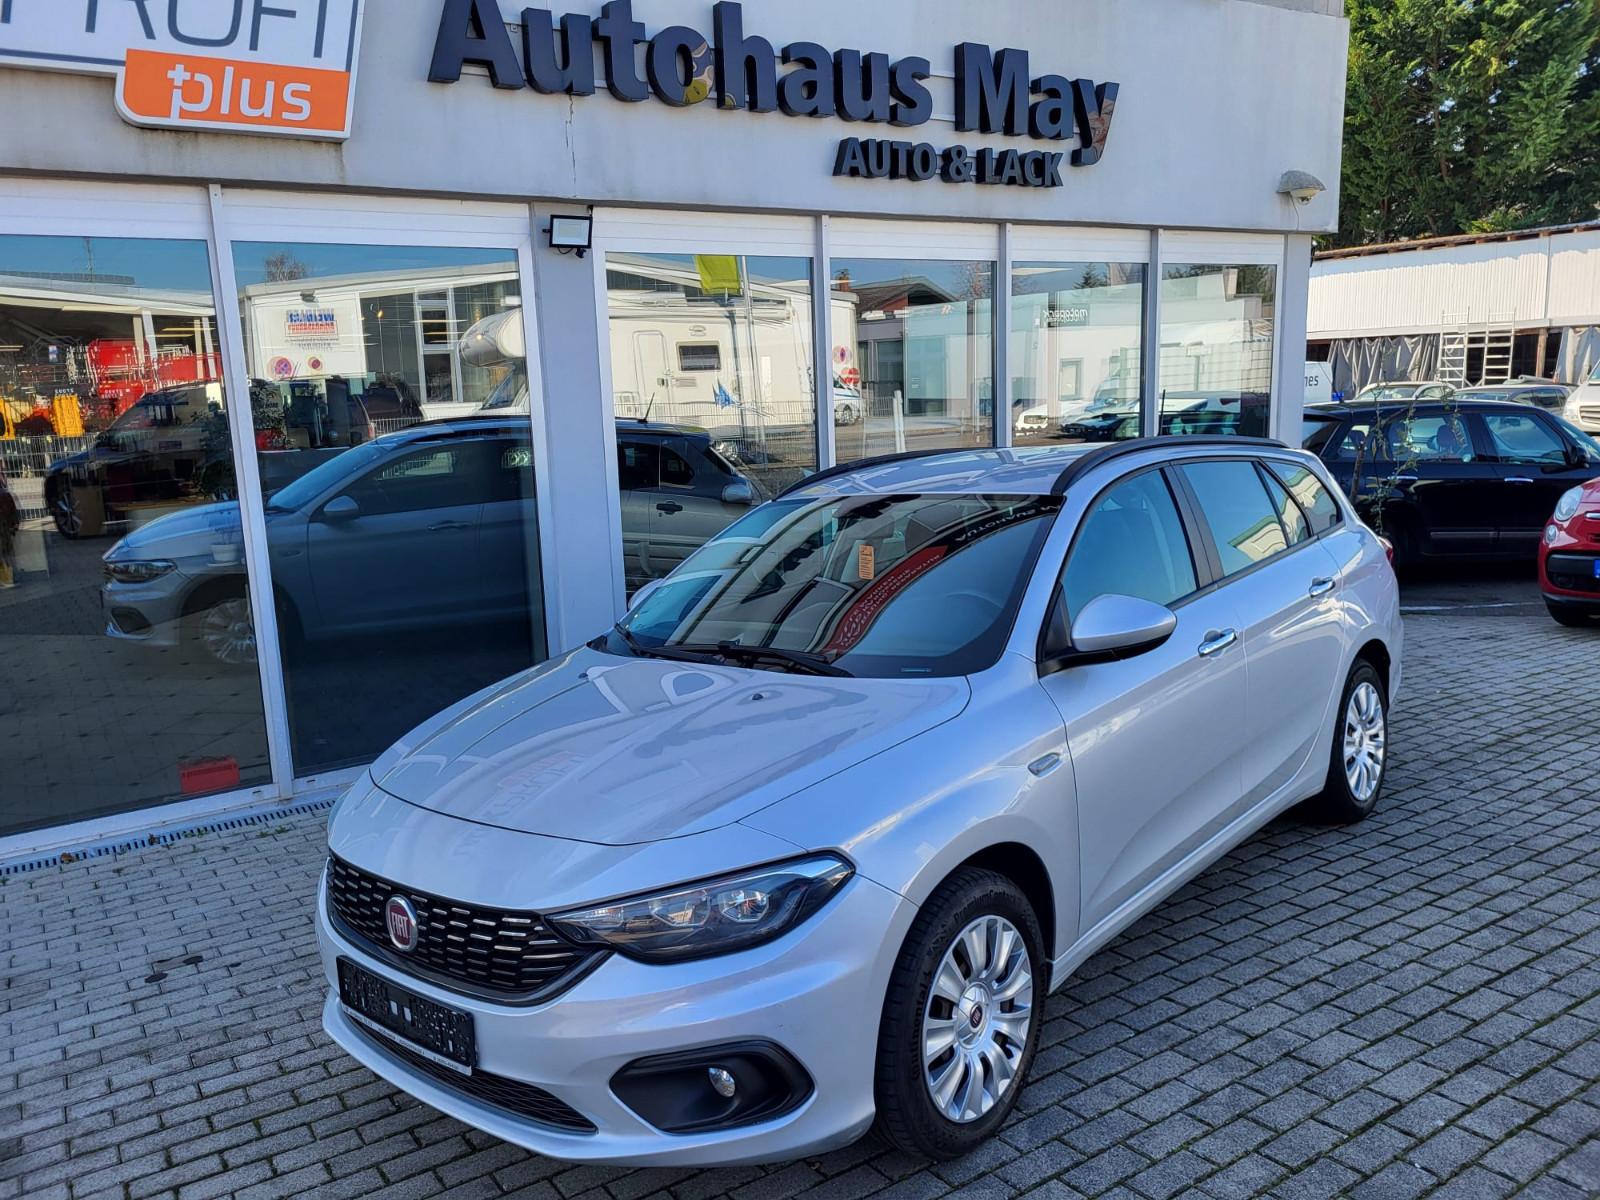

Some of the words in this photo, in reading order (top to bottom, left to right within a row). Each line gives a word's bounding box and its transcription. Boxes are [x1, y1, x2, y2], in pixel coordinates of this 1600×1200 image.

[0, 0, 329, 59] OFI
[166, 64, 312, 121] plus
[427, 0, 932, 127] Autohaus
[953, 42, 1120, 167] May
[832, 137, 937, 181] AUTO
[940, 145, 973, 183] &
[975, 147, 1064, 188] LACK
[391, 911, 409, 939] FIAT
